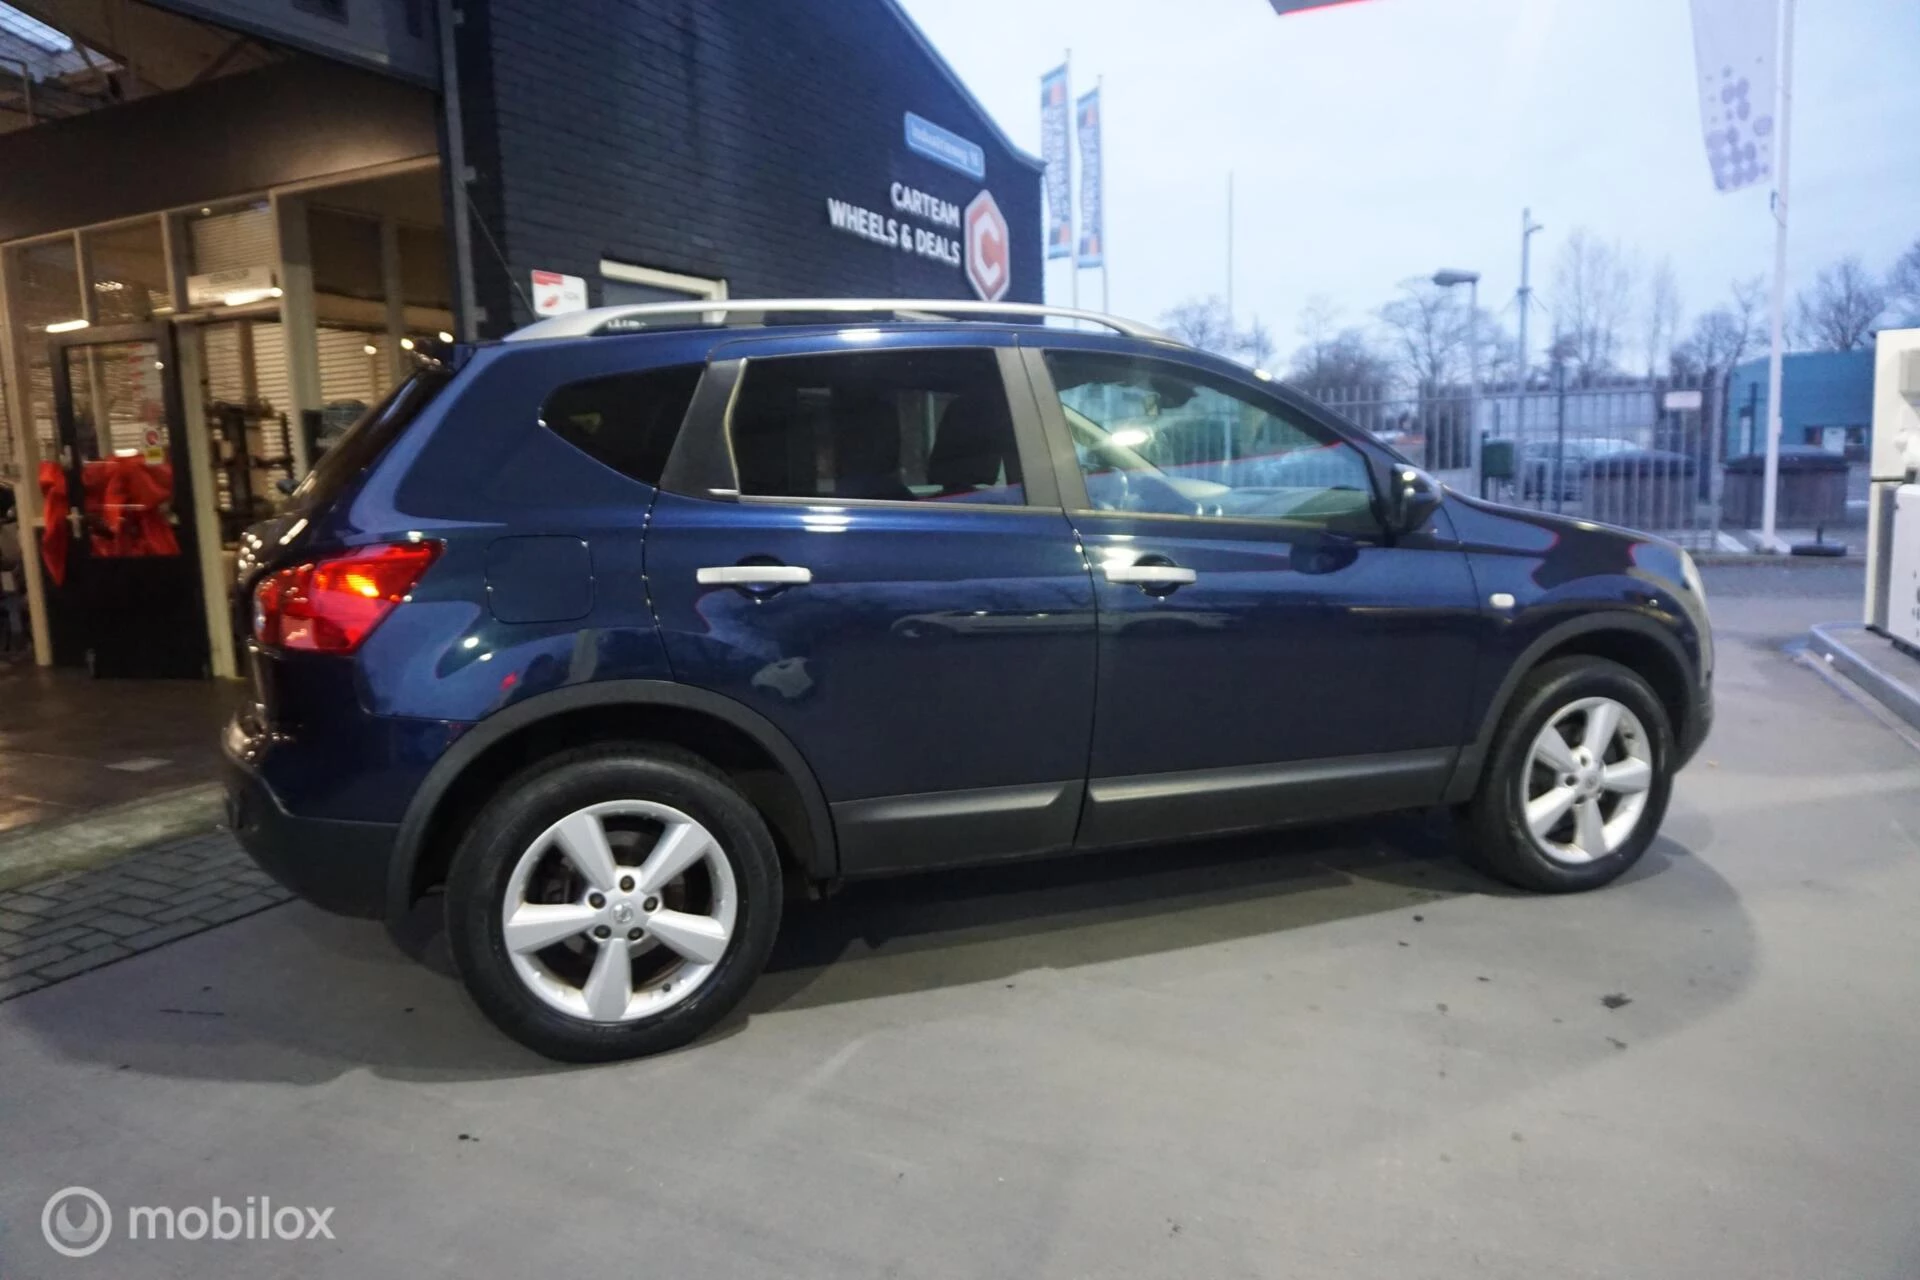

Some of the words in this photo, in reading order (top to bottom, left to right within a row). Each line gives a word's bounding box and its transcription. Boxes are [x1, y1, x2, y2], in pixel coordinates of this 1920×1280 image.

[828, 197, 898, 246] WHEELS
[899, 224, 914, 250] &
[915, 227, 961, 266] DEALS
[891, 182, 959, 227] CARTEAM
